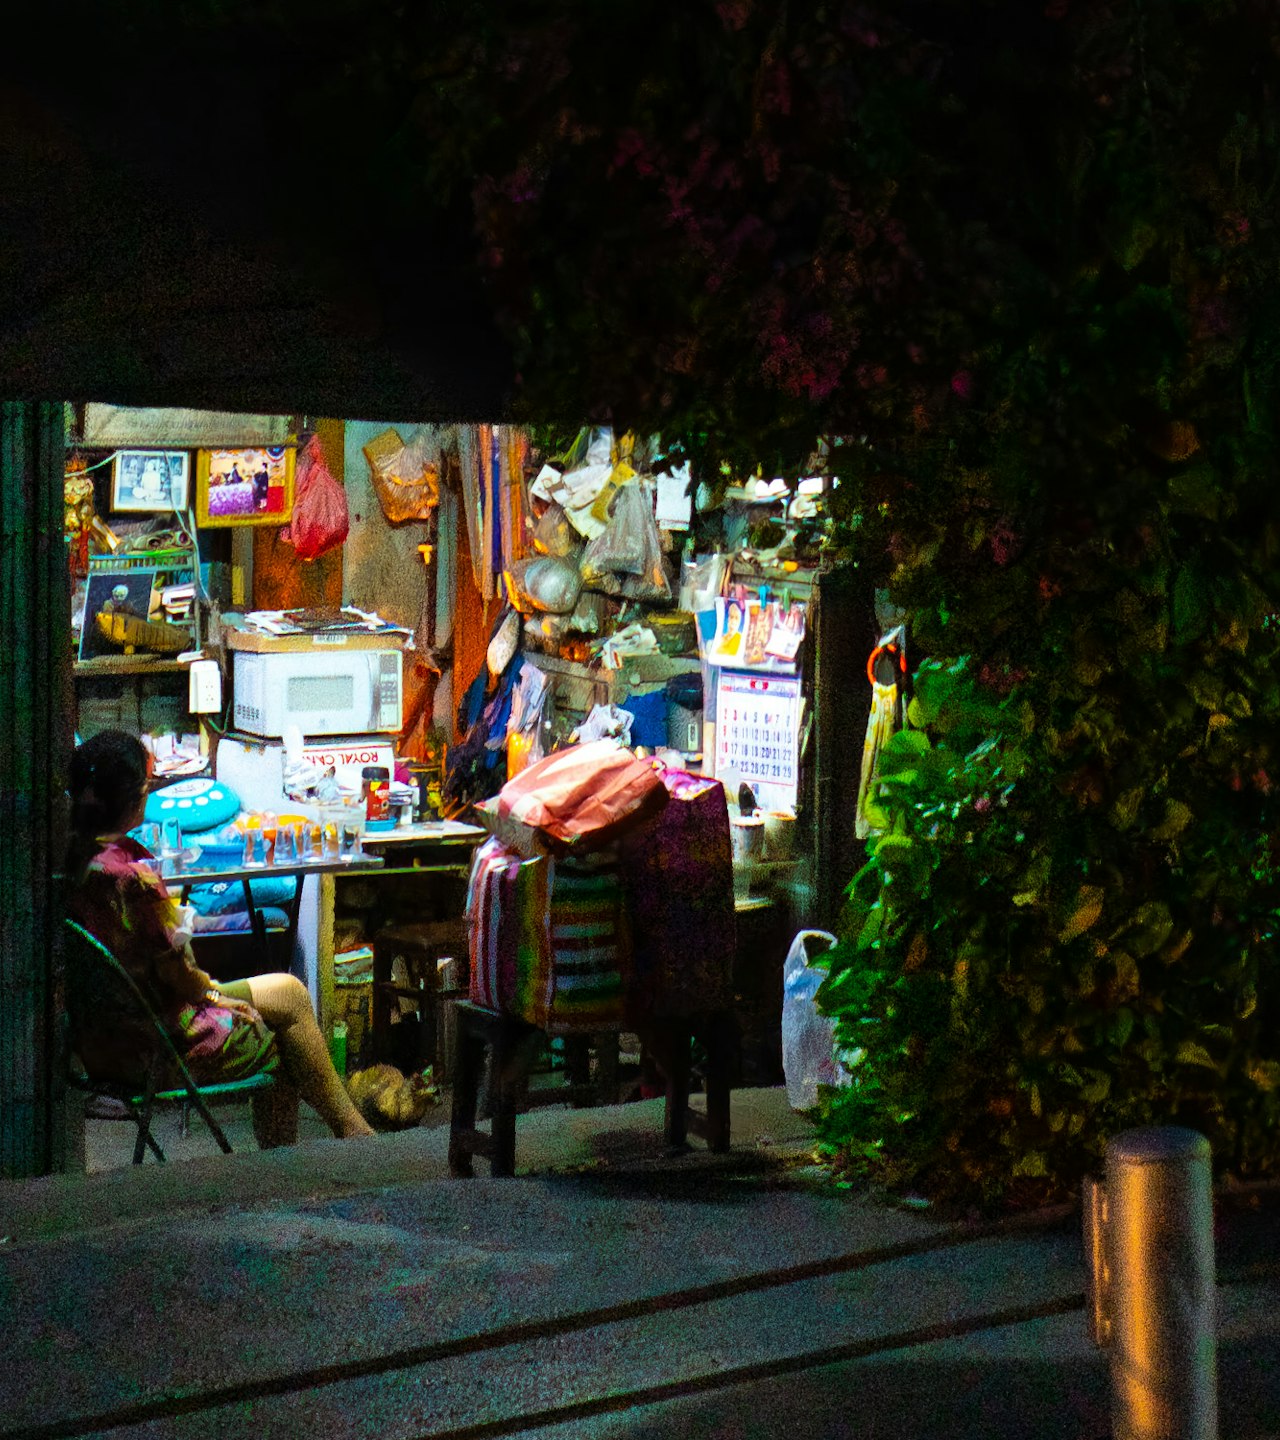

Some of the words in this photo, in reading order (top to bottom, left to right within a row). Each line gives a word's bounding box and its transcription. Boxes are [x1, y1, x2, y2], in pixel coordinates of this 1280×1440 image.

[742, 728, 748, 738] 11
[752, 728, 758, 740] 12
[763, 730, 769, 742] 13
[773, 731, 780, 742] 14
[785, 731, 791, 744] 15
[338, 752, 379, 765] ROYAL
[731, 743, 738, 754] 17
[742, 744, 748, 756] 18
[752, 746, 758, 757] 19
[762, 747, 770, 758] 20
[773, 748, 779, 759] 21
[784, 748, 791, 760] 22
[741, 761, 748, 772] 25
[751, 762, 758, 774] 26
[760, 764, 769, 776] 27
[772, 765, 780, 776] 28
[783, 766, 791, 778] 29
